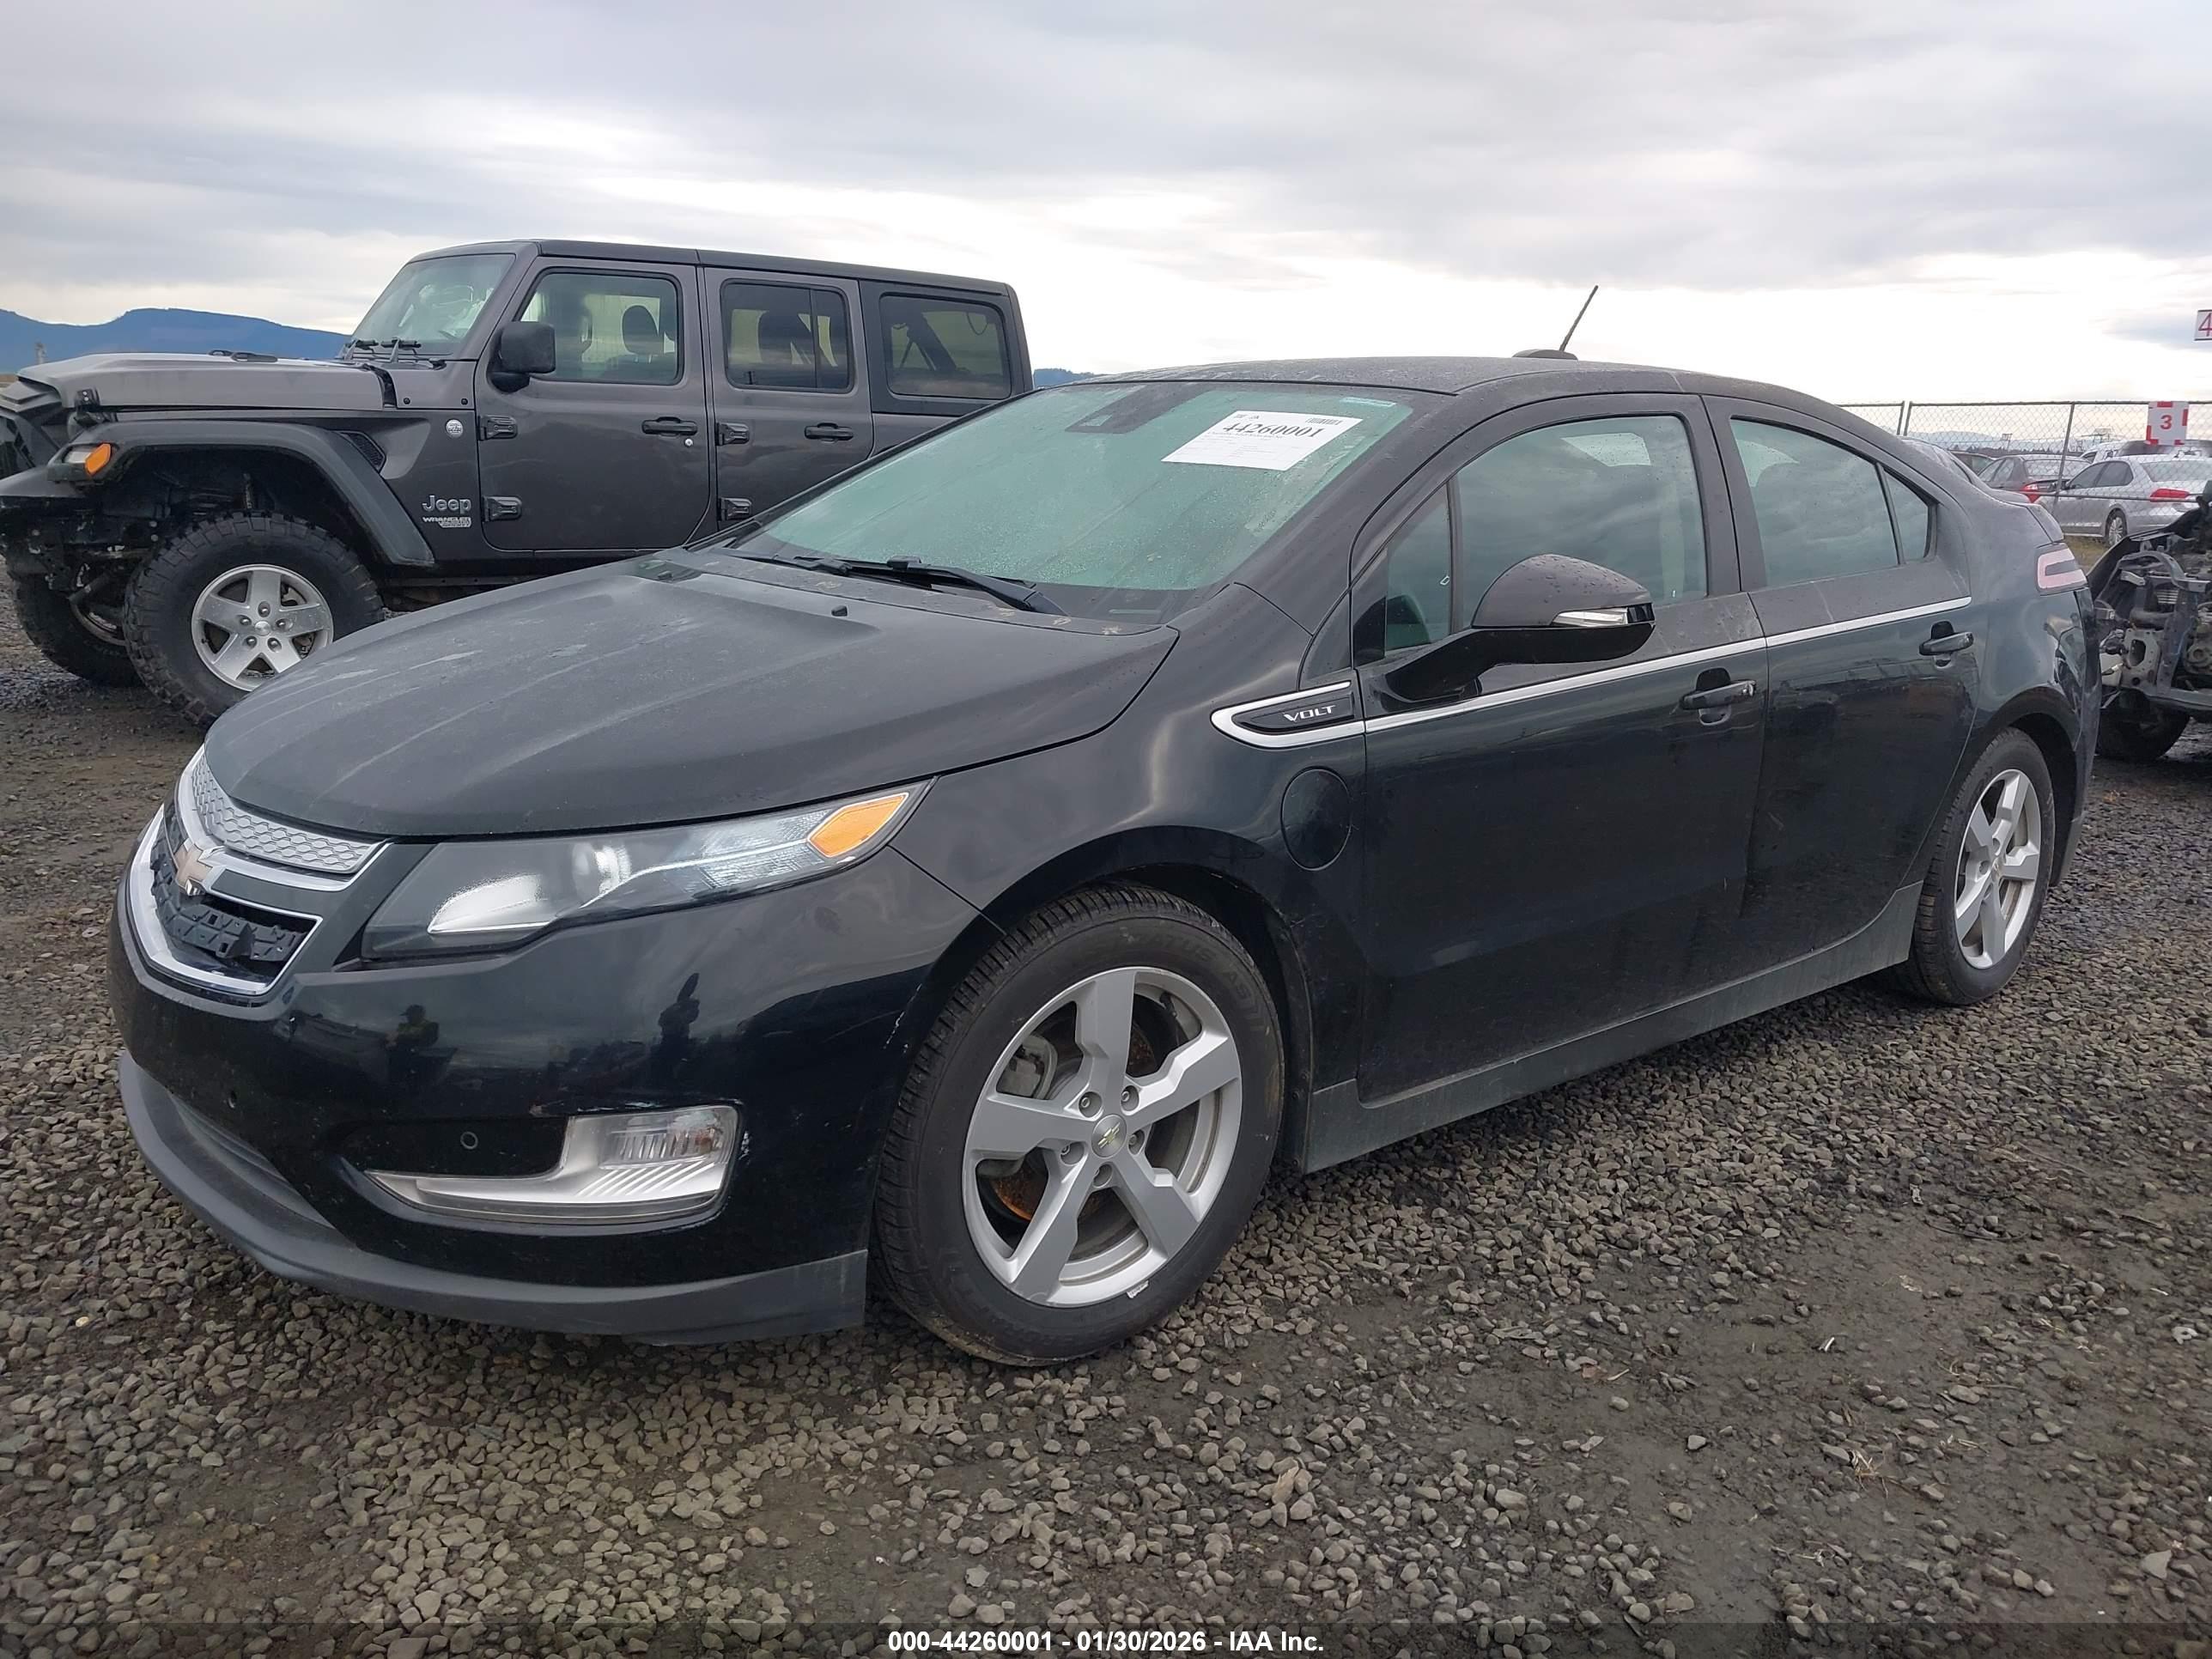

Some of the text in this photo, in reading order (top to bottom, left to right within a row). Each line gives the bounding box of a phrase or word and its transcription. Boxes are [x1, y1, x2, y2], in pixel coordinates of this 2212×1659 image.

[1222, 422, 1325, 437] 44260001
[2160, 414, 2172, 430] 3
[422, 495, 471, 514] Jeep
[1283, 704, 1336, 722] VOLT
